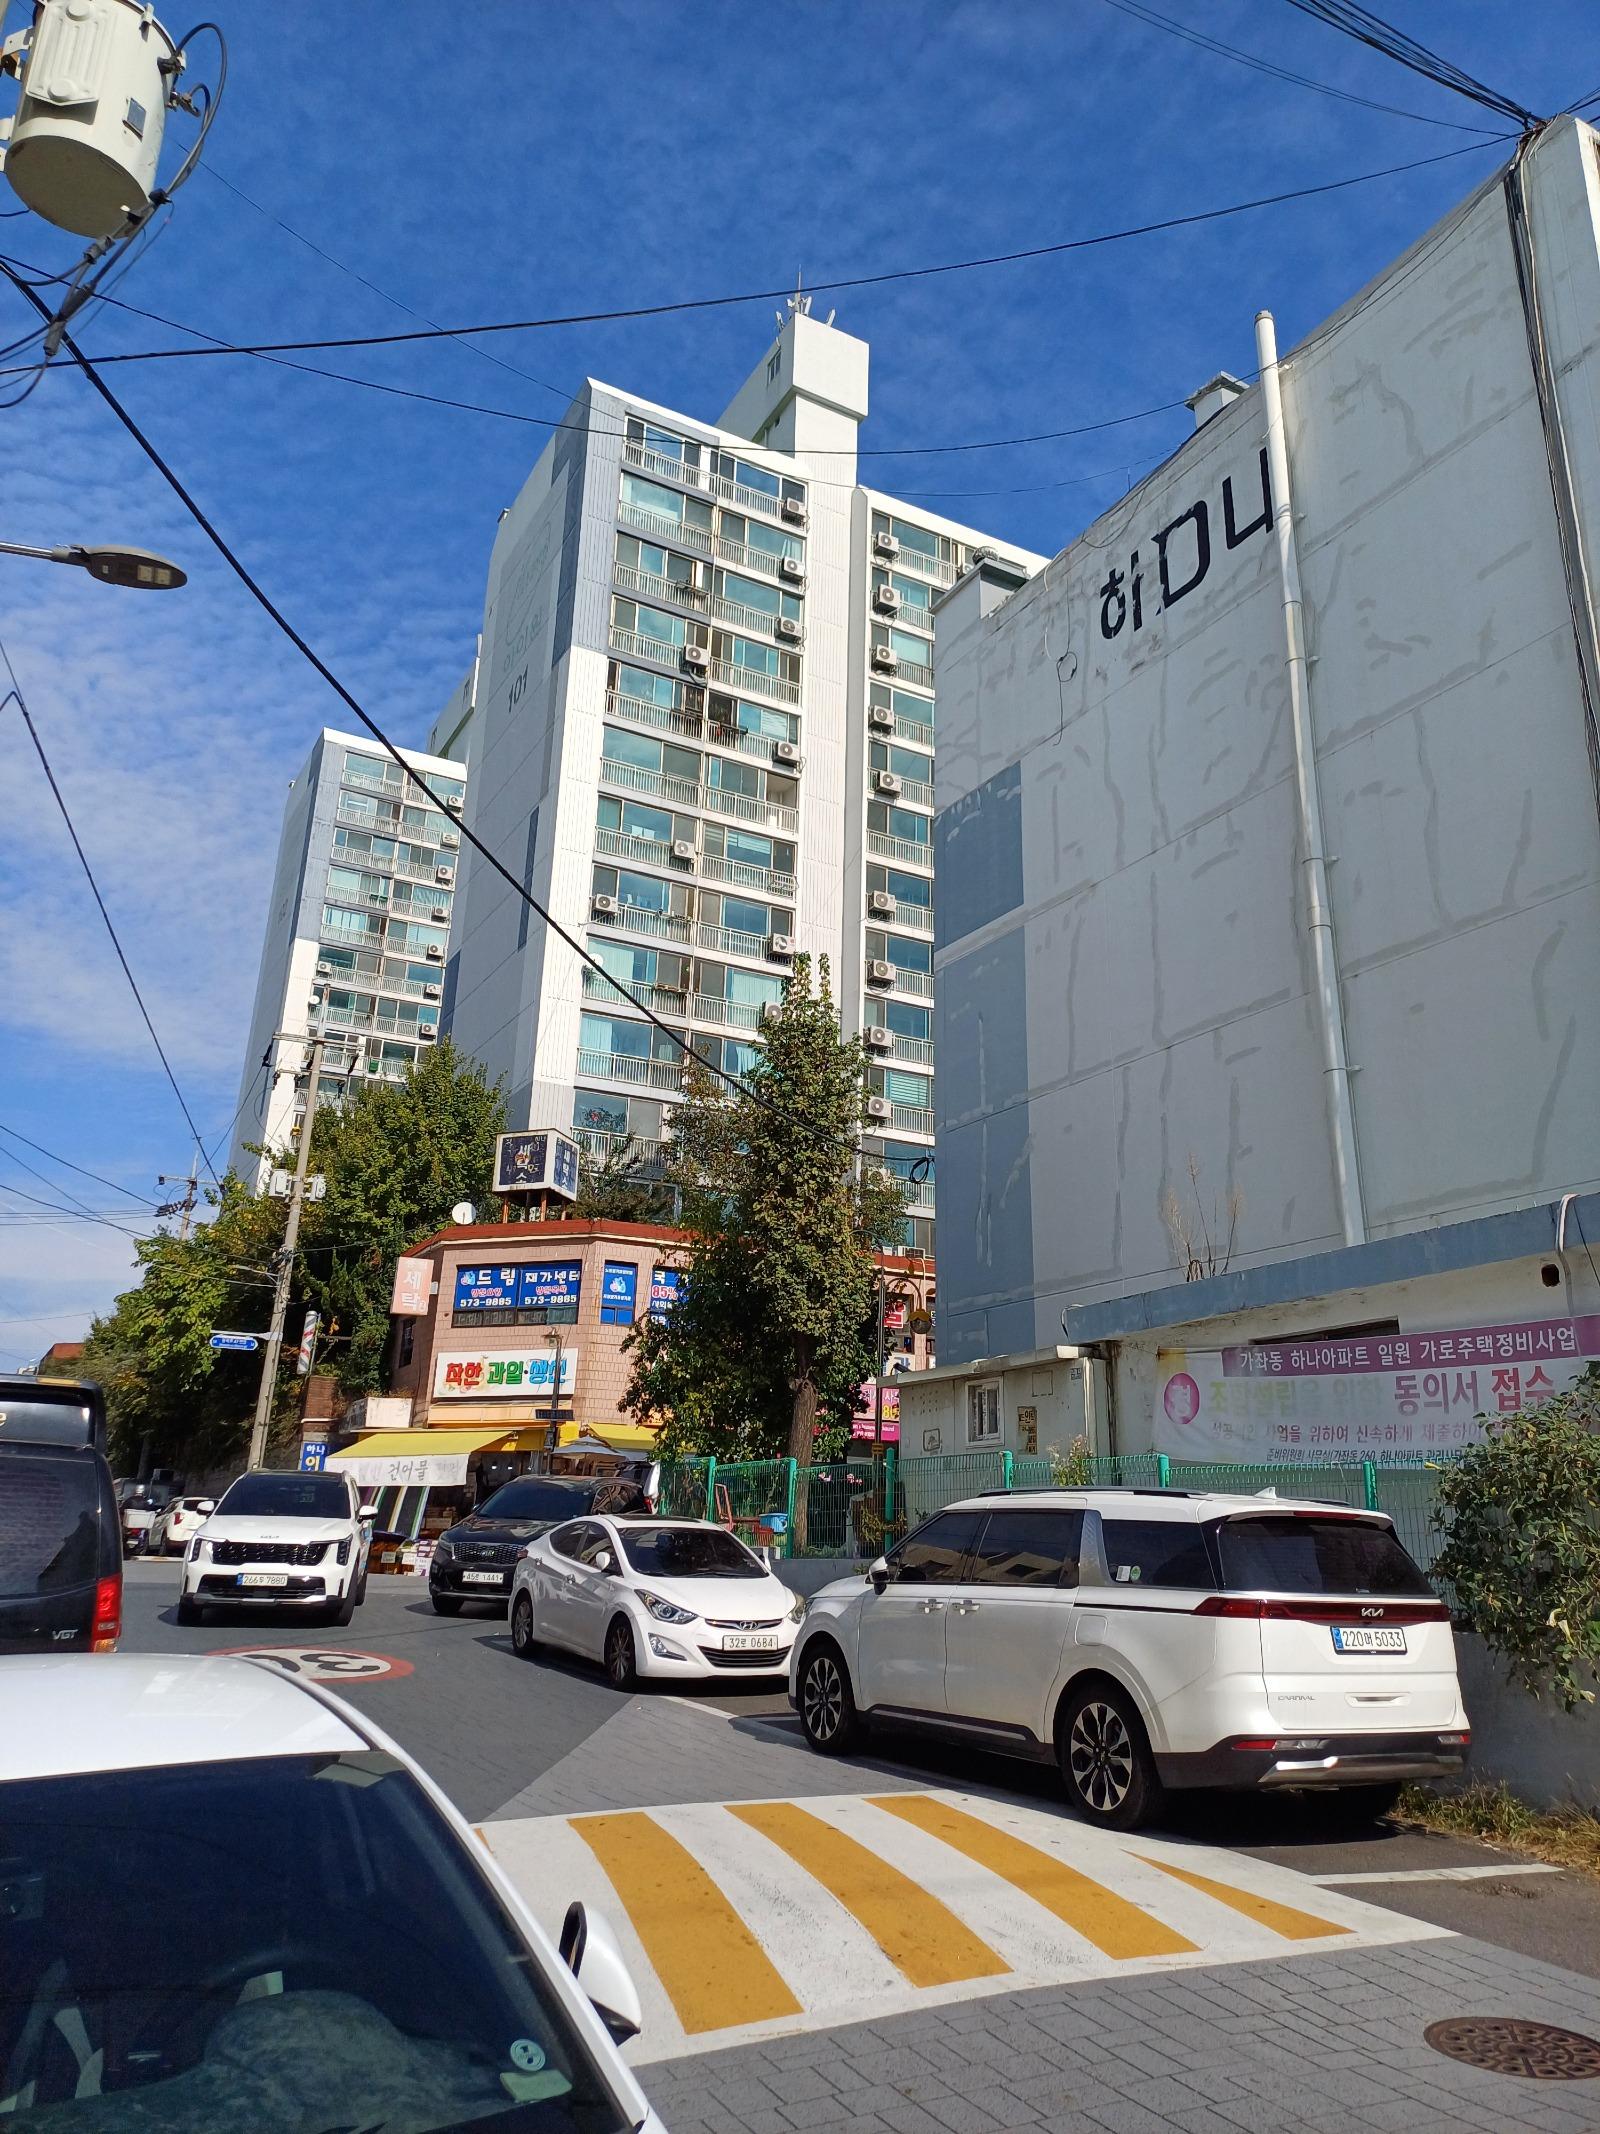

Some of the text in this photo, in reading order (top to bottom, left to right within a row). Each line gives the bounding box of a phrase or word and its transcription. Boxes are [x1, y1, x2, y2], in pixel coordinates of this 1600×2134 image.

[508, 664, 529, 713] 101
[525, 1270, 581, 1285] 재가센터
[652, 1284, 679, 1300] 85%
[1240, 1326, 1577, 1371] 가좌동 하나아파트 일원 가로주택정비사업
[446, 1362, 482, 1386] 착한
[1394, 1370, 1479, 1416] 동의서
[1491, 1365, 1555, 1412] 접수
[1310, 1425, 1349, 1443] 위하여
[1356, 1423, 1413, 1443] 신속하게
[306, 1444, 326, 1455] 하나
[388, 1460, 429, 1482] 건어물
[52, 1629, 78, 1640] VGT
[750, 1637, 773, 1648] 0684
[1375, 1631, 1403, 1648] 5033
